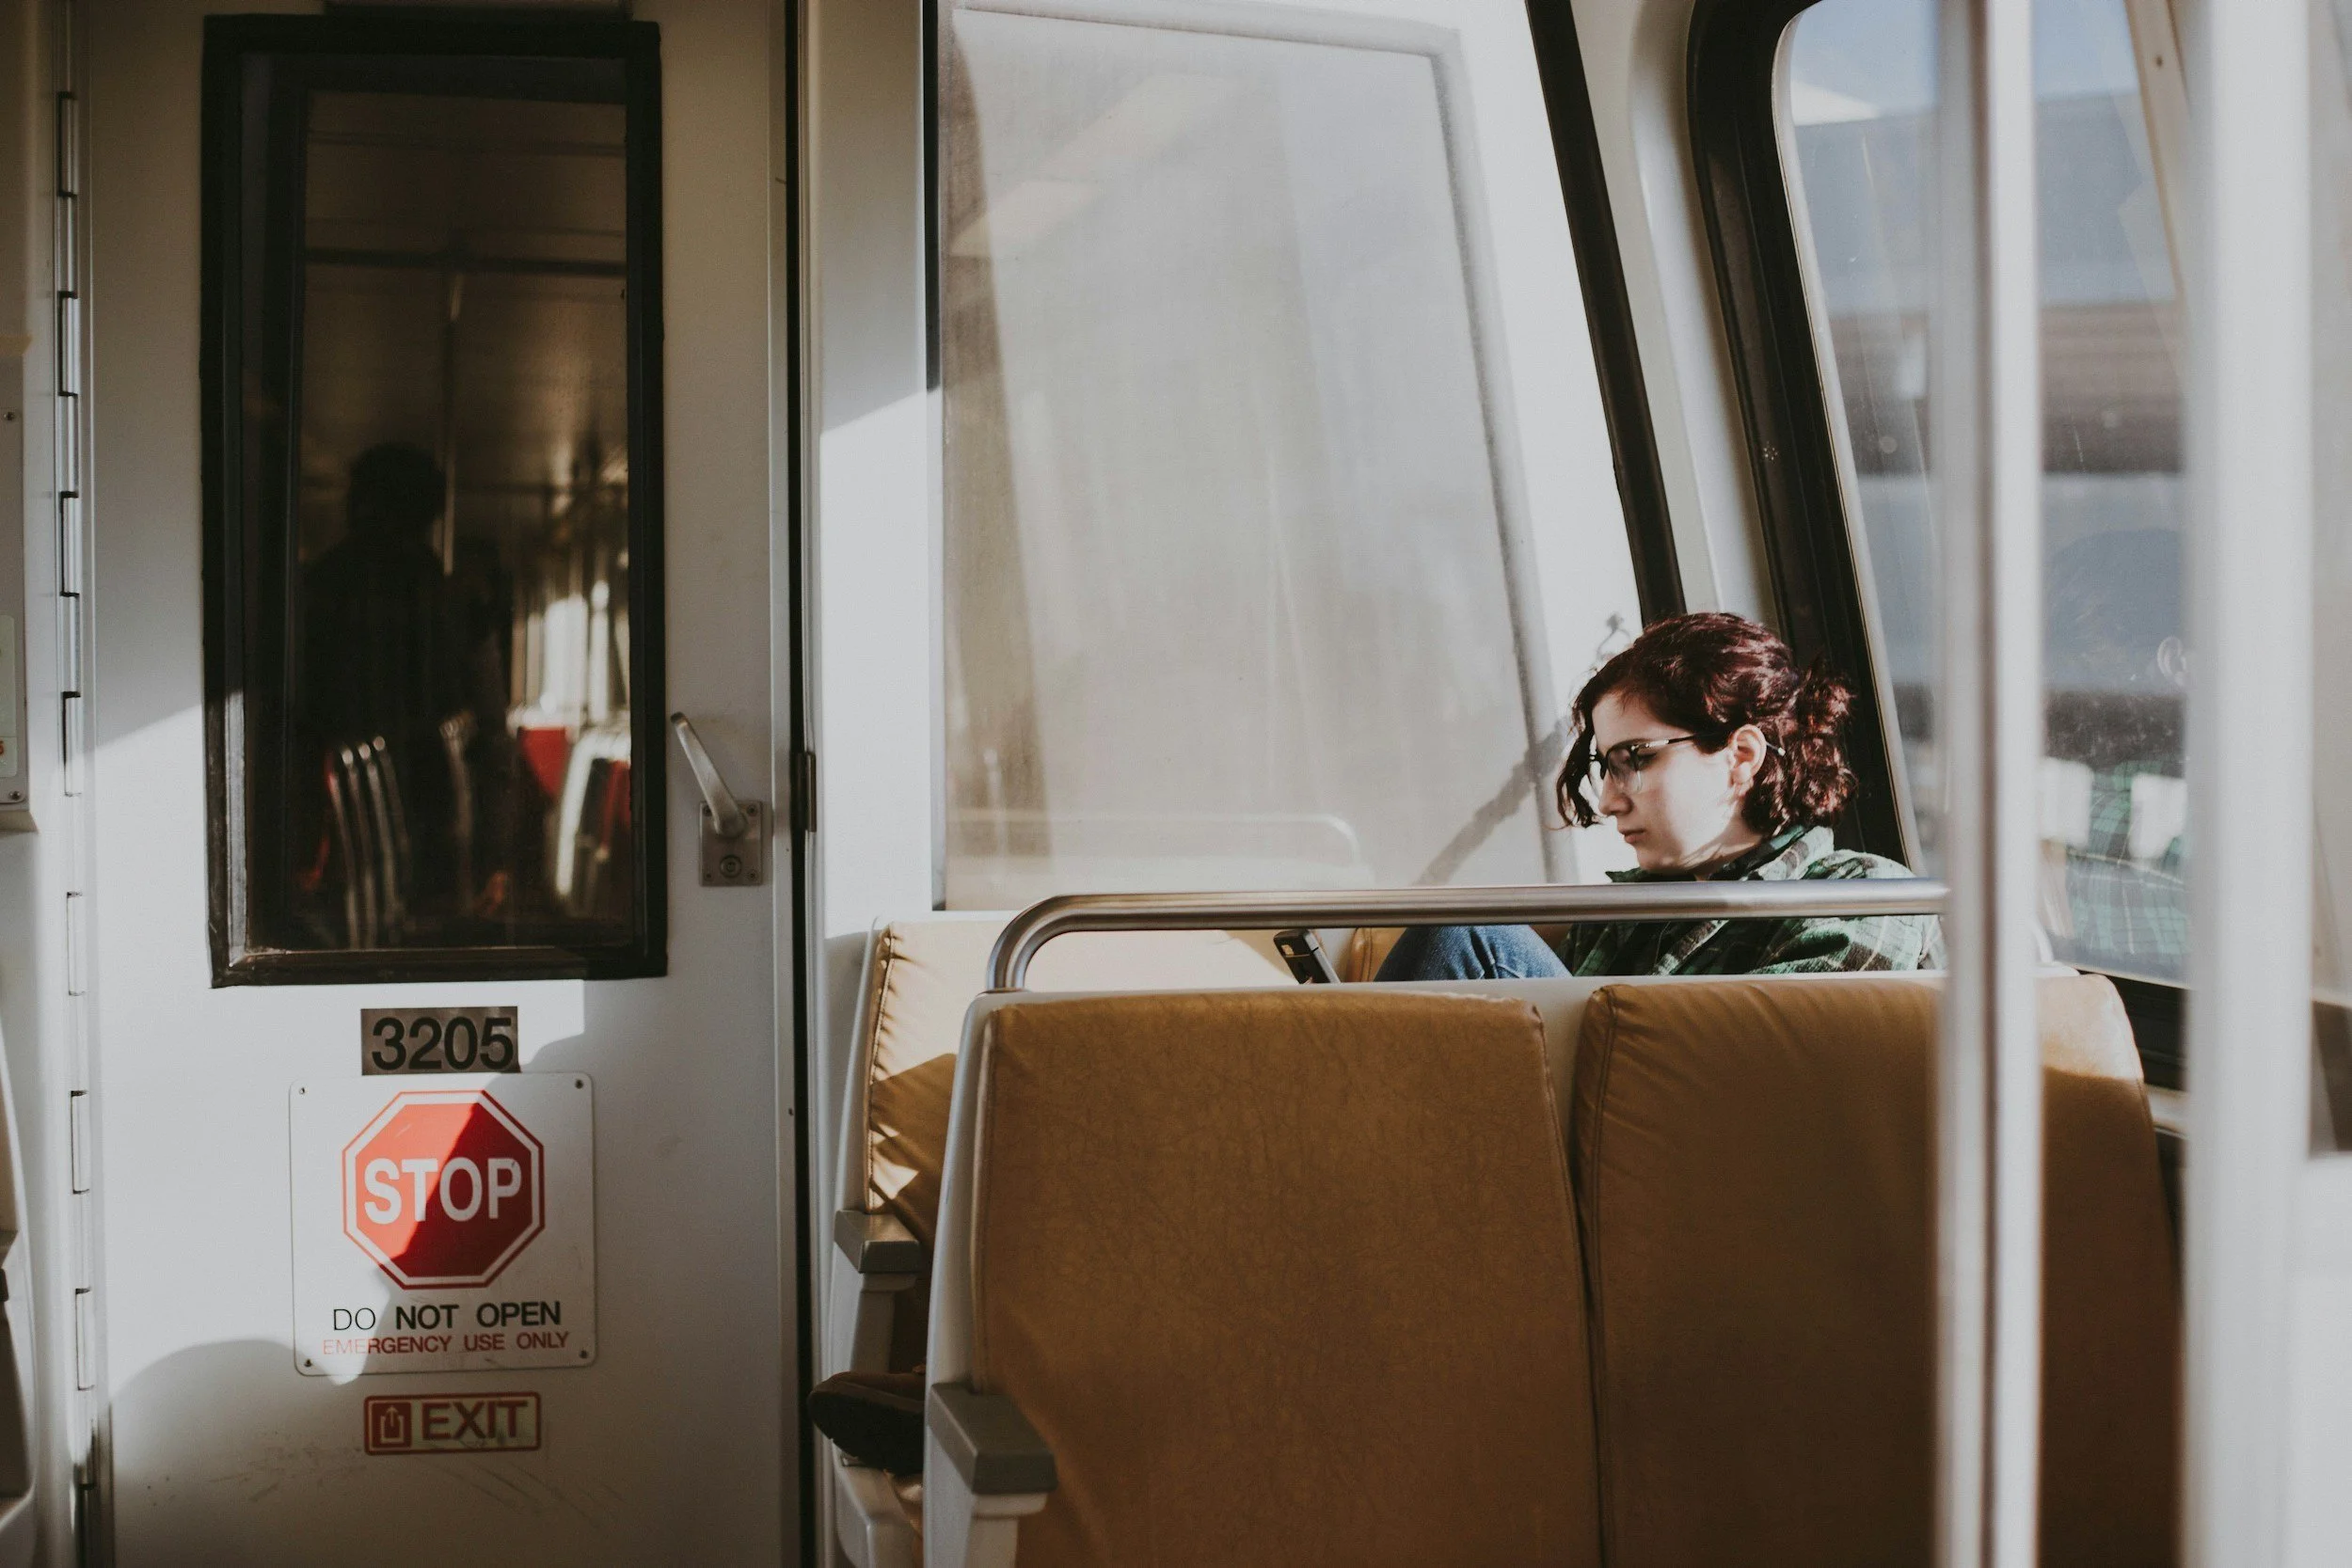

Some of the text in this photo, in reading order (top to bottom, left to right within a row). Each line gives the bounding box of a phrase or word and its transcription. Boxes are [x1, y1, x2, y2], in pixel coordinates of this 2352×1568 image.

[372, 1017, 515, 1071] 3205
[363, 1156, 522, 1225] STOP
[333, 1300, 561, 1331] DO NOT OPEN
[323, 1330, 569, 1354] EMERGENCY USE ONLY
[421, 1400, 529, 1440] EXIT
